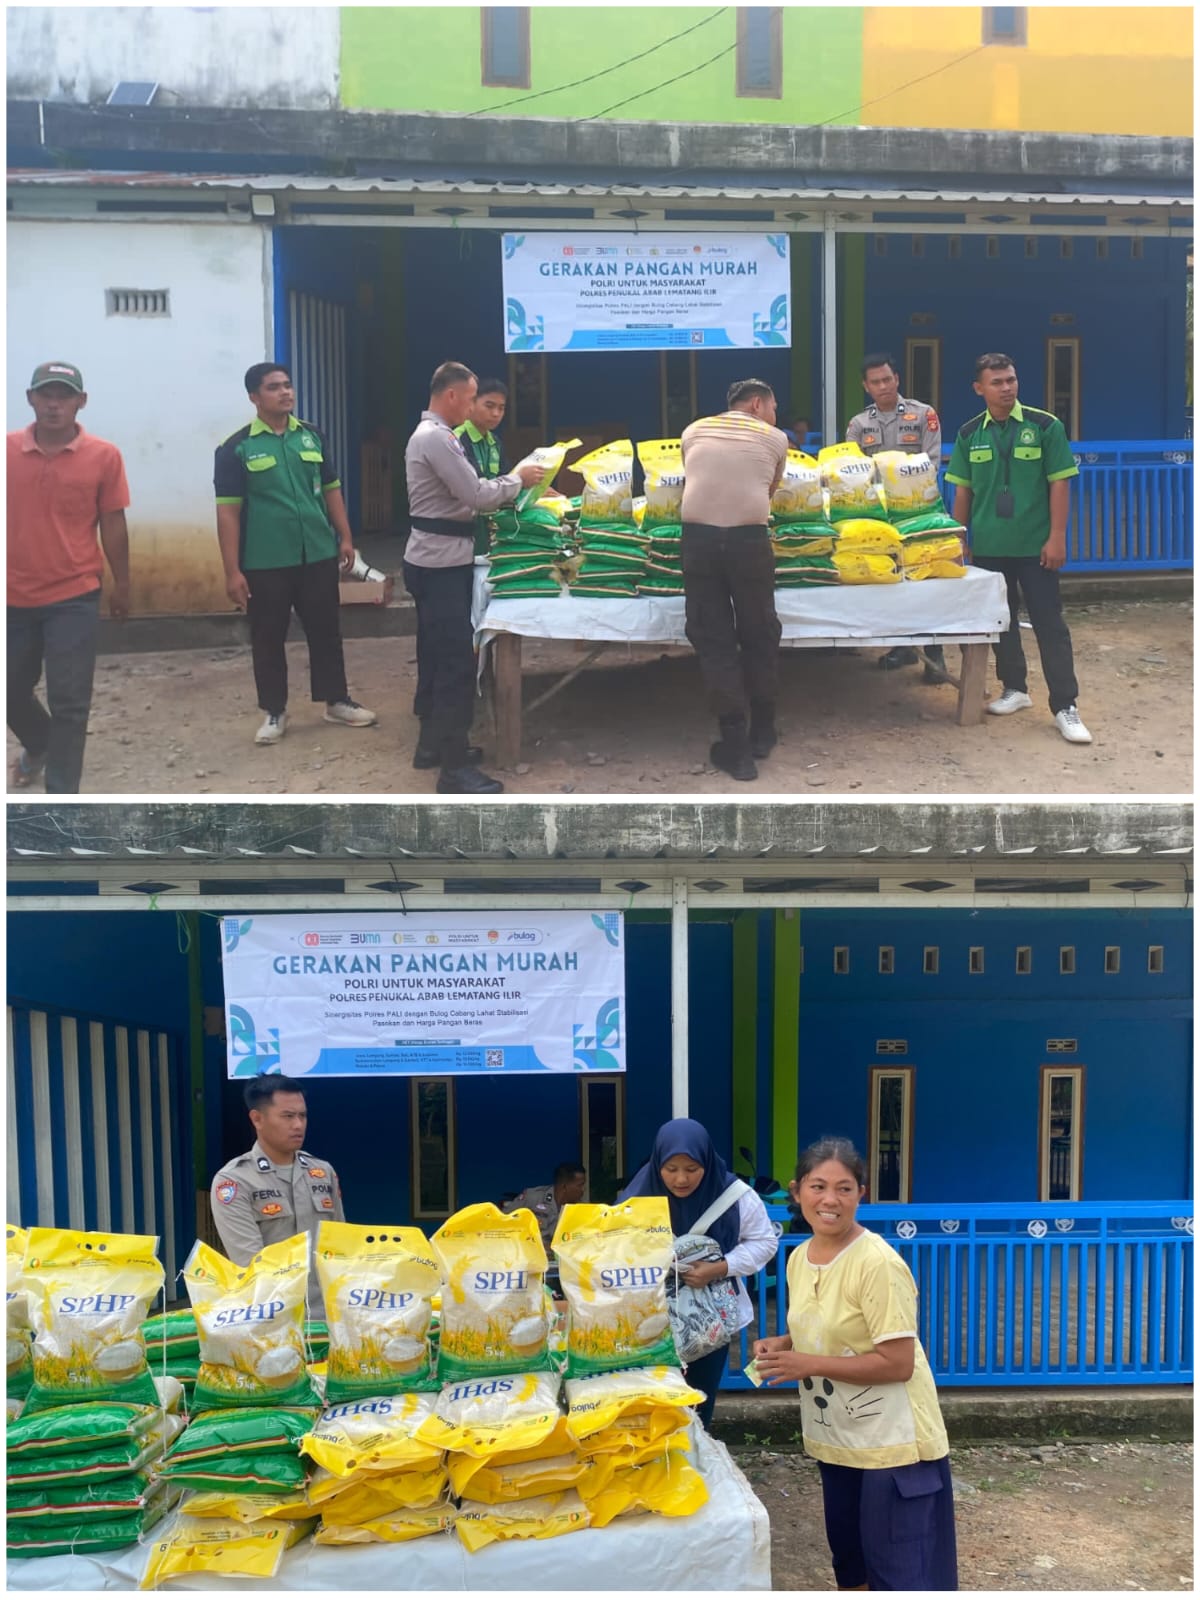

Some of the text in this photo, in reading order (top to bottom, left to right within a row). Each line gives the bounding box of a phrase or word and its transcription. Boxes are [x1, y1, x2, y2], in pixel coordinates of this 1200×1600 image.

[539, 261, 757, 276] GERAKAN PANGAN MURAH
[591, 279, 706, 288] POLRI UNTUK MASYARAKAT
[840, 463, 871, 475] SPHP
[900, 461, 931, 476] SPHP
[597, 471, 631, 486] SPHP
[661, 476, 685, 486] SPH
[513, 931, 536, 941] bulog
[273, 951, 578, 974] GERAKAN PANGAN MURAH
[344, 977, 505, 989] POLRI UNTUK MASYARAKAT
[330, 991, 521, 1002] POLRES PENUKAL ABAB LEMATANG ILIR
[404, 1010, 428, 1018] dengan
[437, 1019, 462, 1027] Pangan
[474, 1270, 529, 1290] SPH
[601, 1266, 663, 1288] SPHP
[59, 1293, 136, 1314] SPHP
[348, 1288, 414, 1309] SPHP
[213, 1300, 285, 1329] SPHP
[485, 1345, 493, 1356] 5
[615, 1342, 623, 1352] 5
[360, 1364, 369, 1374] 5
[68, 1373, 78, 1383] 5
[235, 1377, 244, 1388] 5
[450, 1379, 514, 1403] SPHP
[322, 1398, 393, 1422] SPHP
